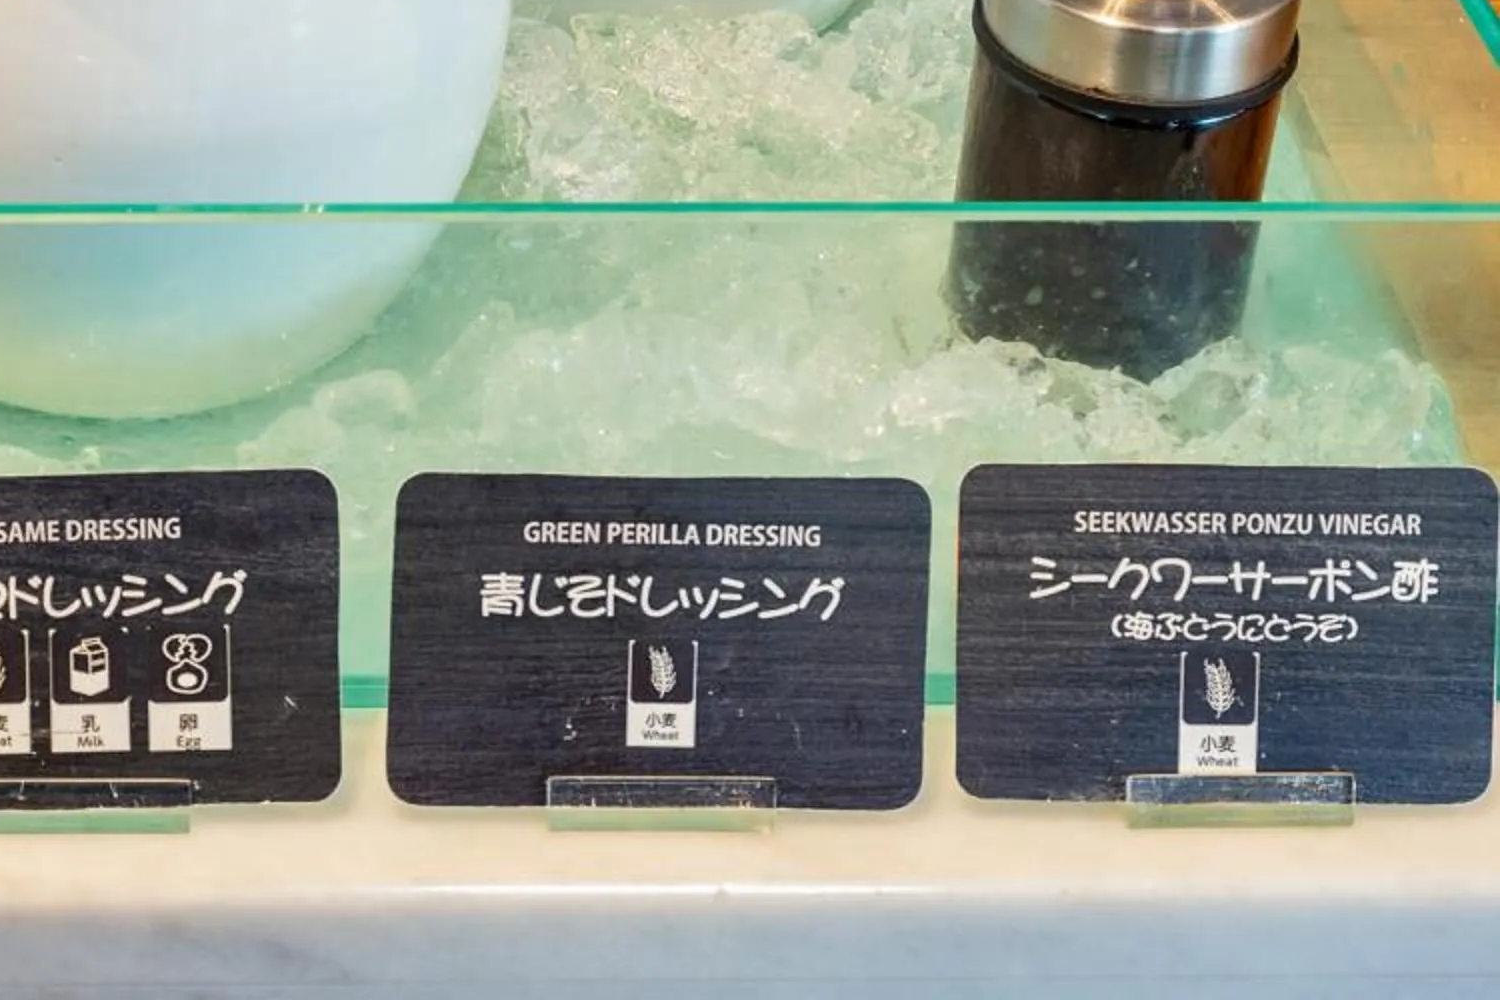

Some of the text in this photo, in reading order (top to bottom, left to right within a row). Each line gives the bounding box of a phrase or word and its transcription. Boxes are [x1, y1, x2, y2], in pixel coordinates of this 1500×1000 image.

[65, 517, 181, 542] DRESSING
[1074, 510, 1422, 536] SEEKWASSER PONZU VINEGAR
[523, 521, 821, 547] GREEN PERILLA DRESSING
[1029, 556, 1440, 604] シークワーサーポン酢
[479, 571, 846, 622] 青じそドレッシング
[81, 715, 100, 733] 乳
[179, 714, 198, 732] 卵
[645, 713, 676, 728] 小麦
[77, 737, 105, 748] Milk
[642, 731, 679, 740] Wheat
[1200, 735, 1236, 752] 小麦
[1196, 756, 1239, 767] Wheat
